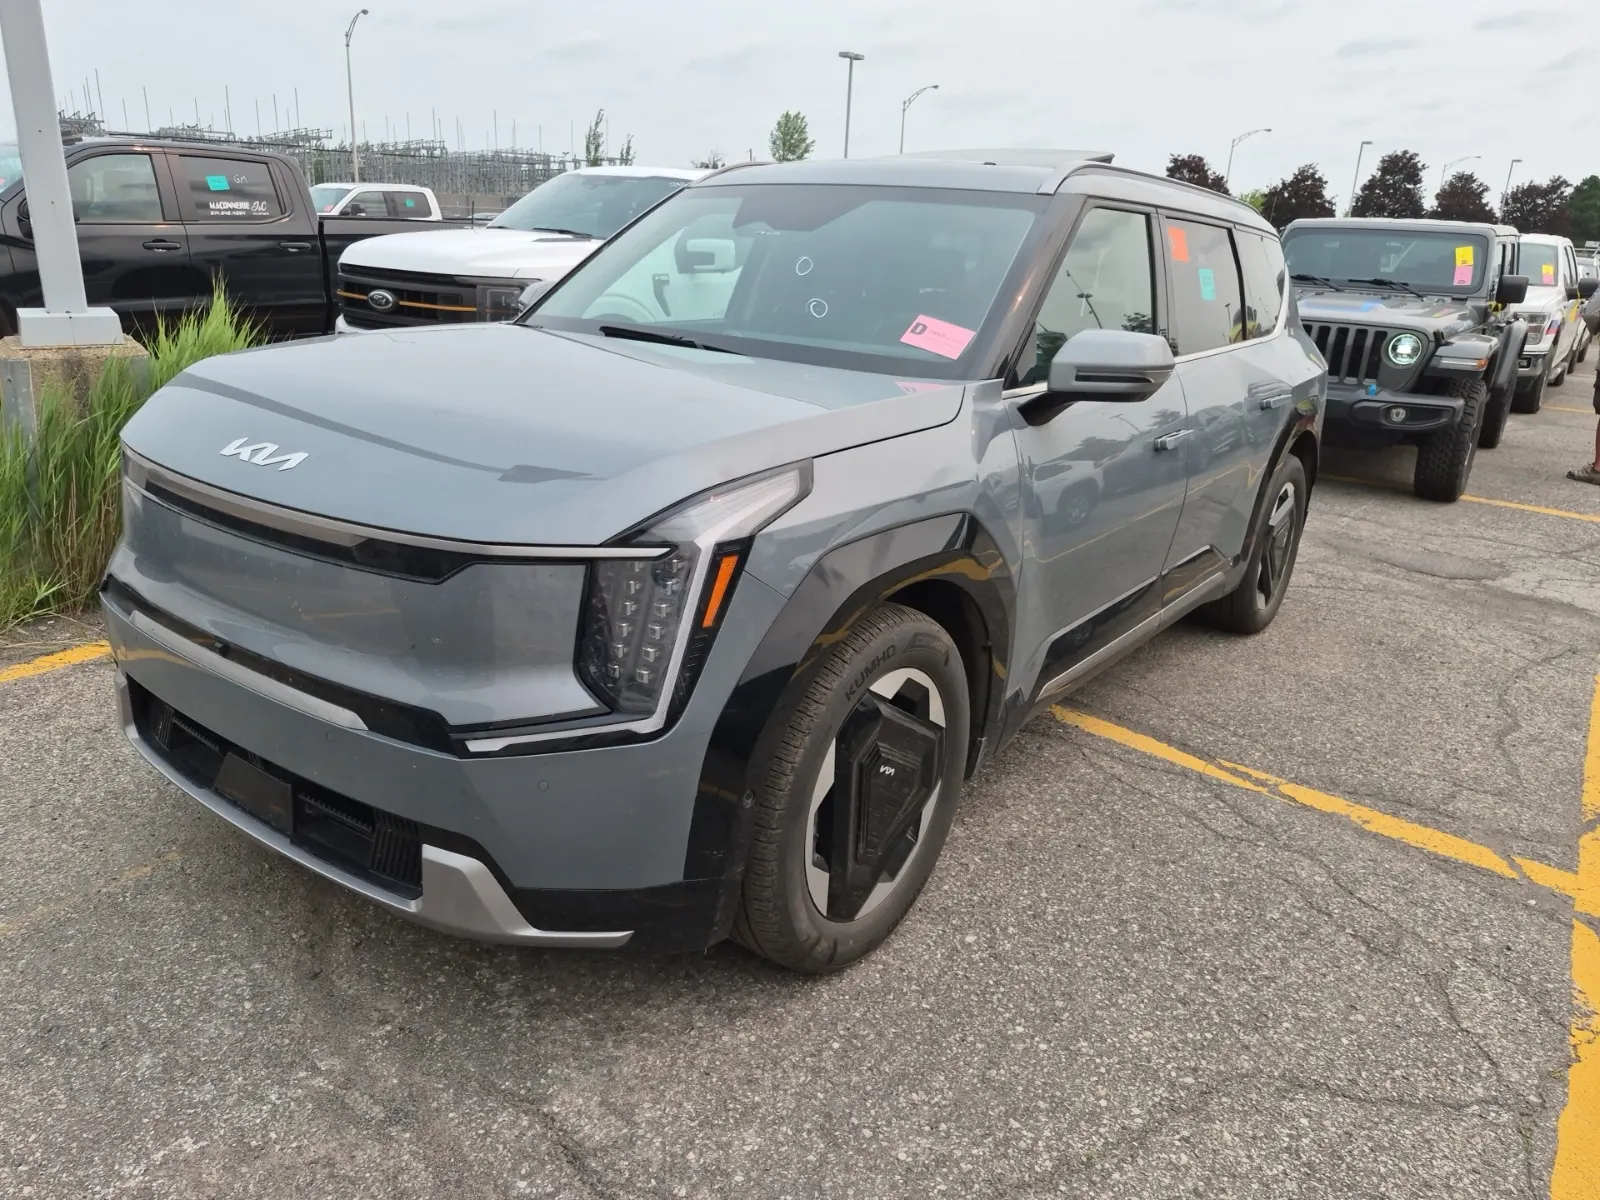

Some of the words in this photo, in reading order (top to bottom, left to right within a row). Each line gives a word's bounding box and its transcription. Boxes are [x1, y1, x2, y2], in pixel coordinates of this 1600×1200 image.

[209, 202, 250, 210] MAÇONNERIE
[910, 322, 928, 335] D
[220, 437, 309, 472] KIA
[844, 644, 896, 702] KUMHO
[879, 765, 895, 776] KIA
